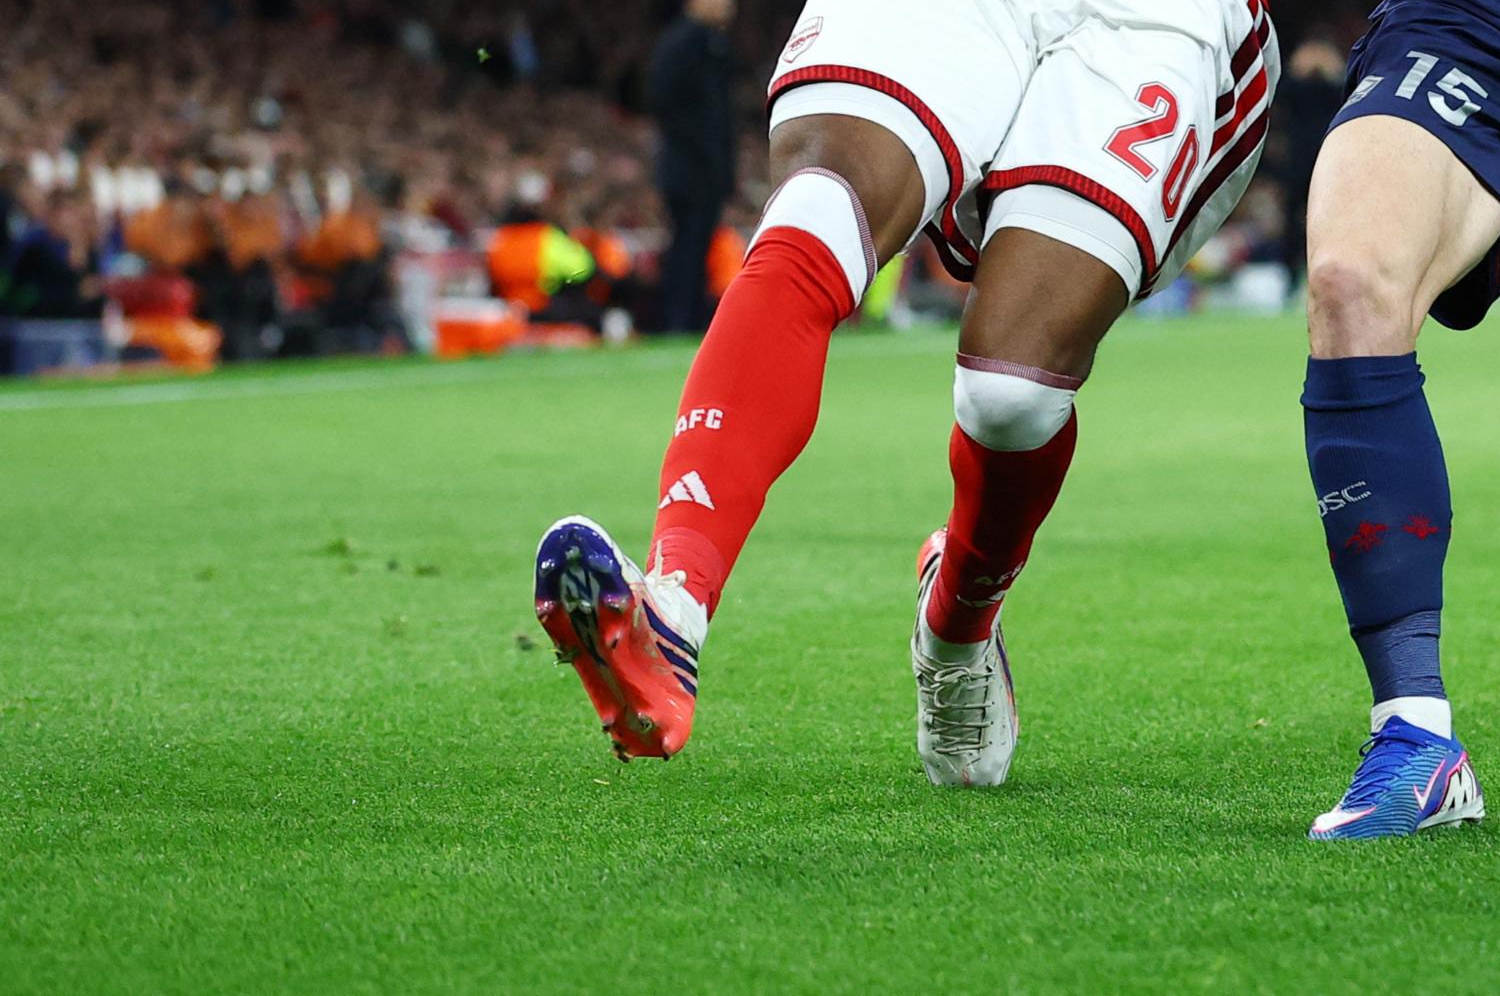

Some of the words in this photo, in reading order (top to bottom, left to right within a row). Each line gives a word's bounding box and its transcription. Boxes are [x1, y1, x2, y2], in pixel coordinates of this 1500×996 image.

[1394, 50, 1489, 127] 15
[1102, 80, 1200, 223] 20
[674, 407, 724, 438] AFC
